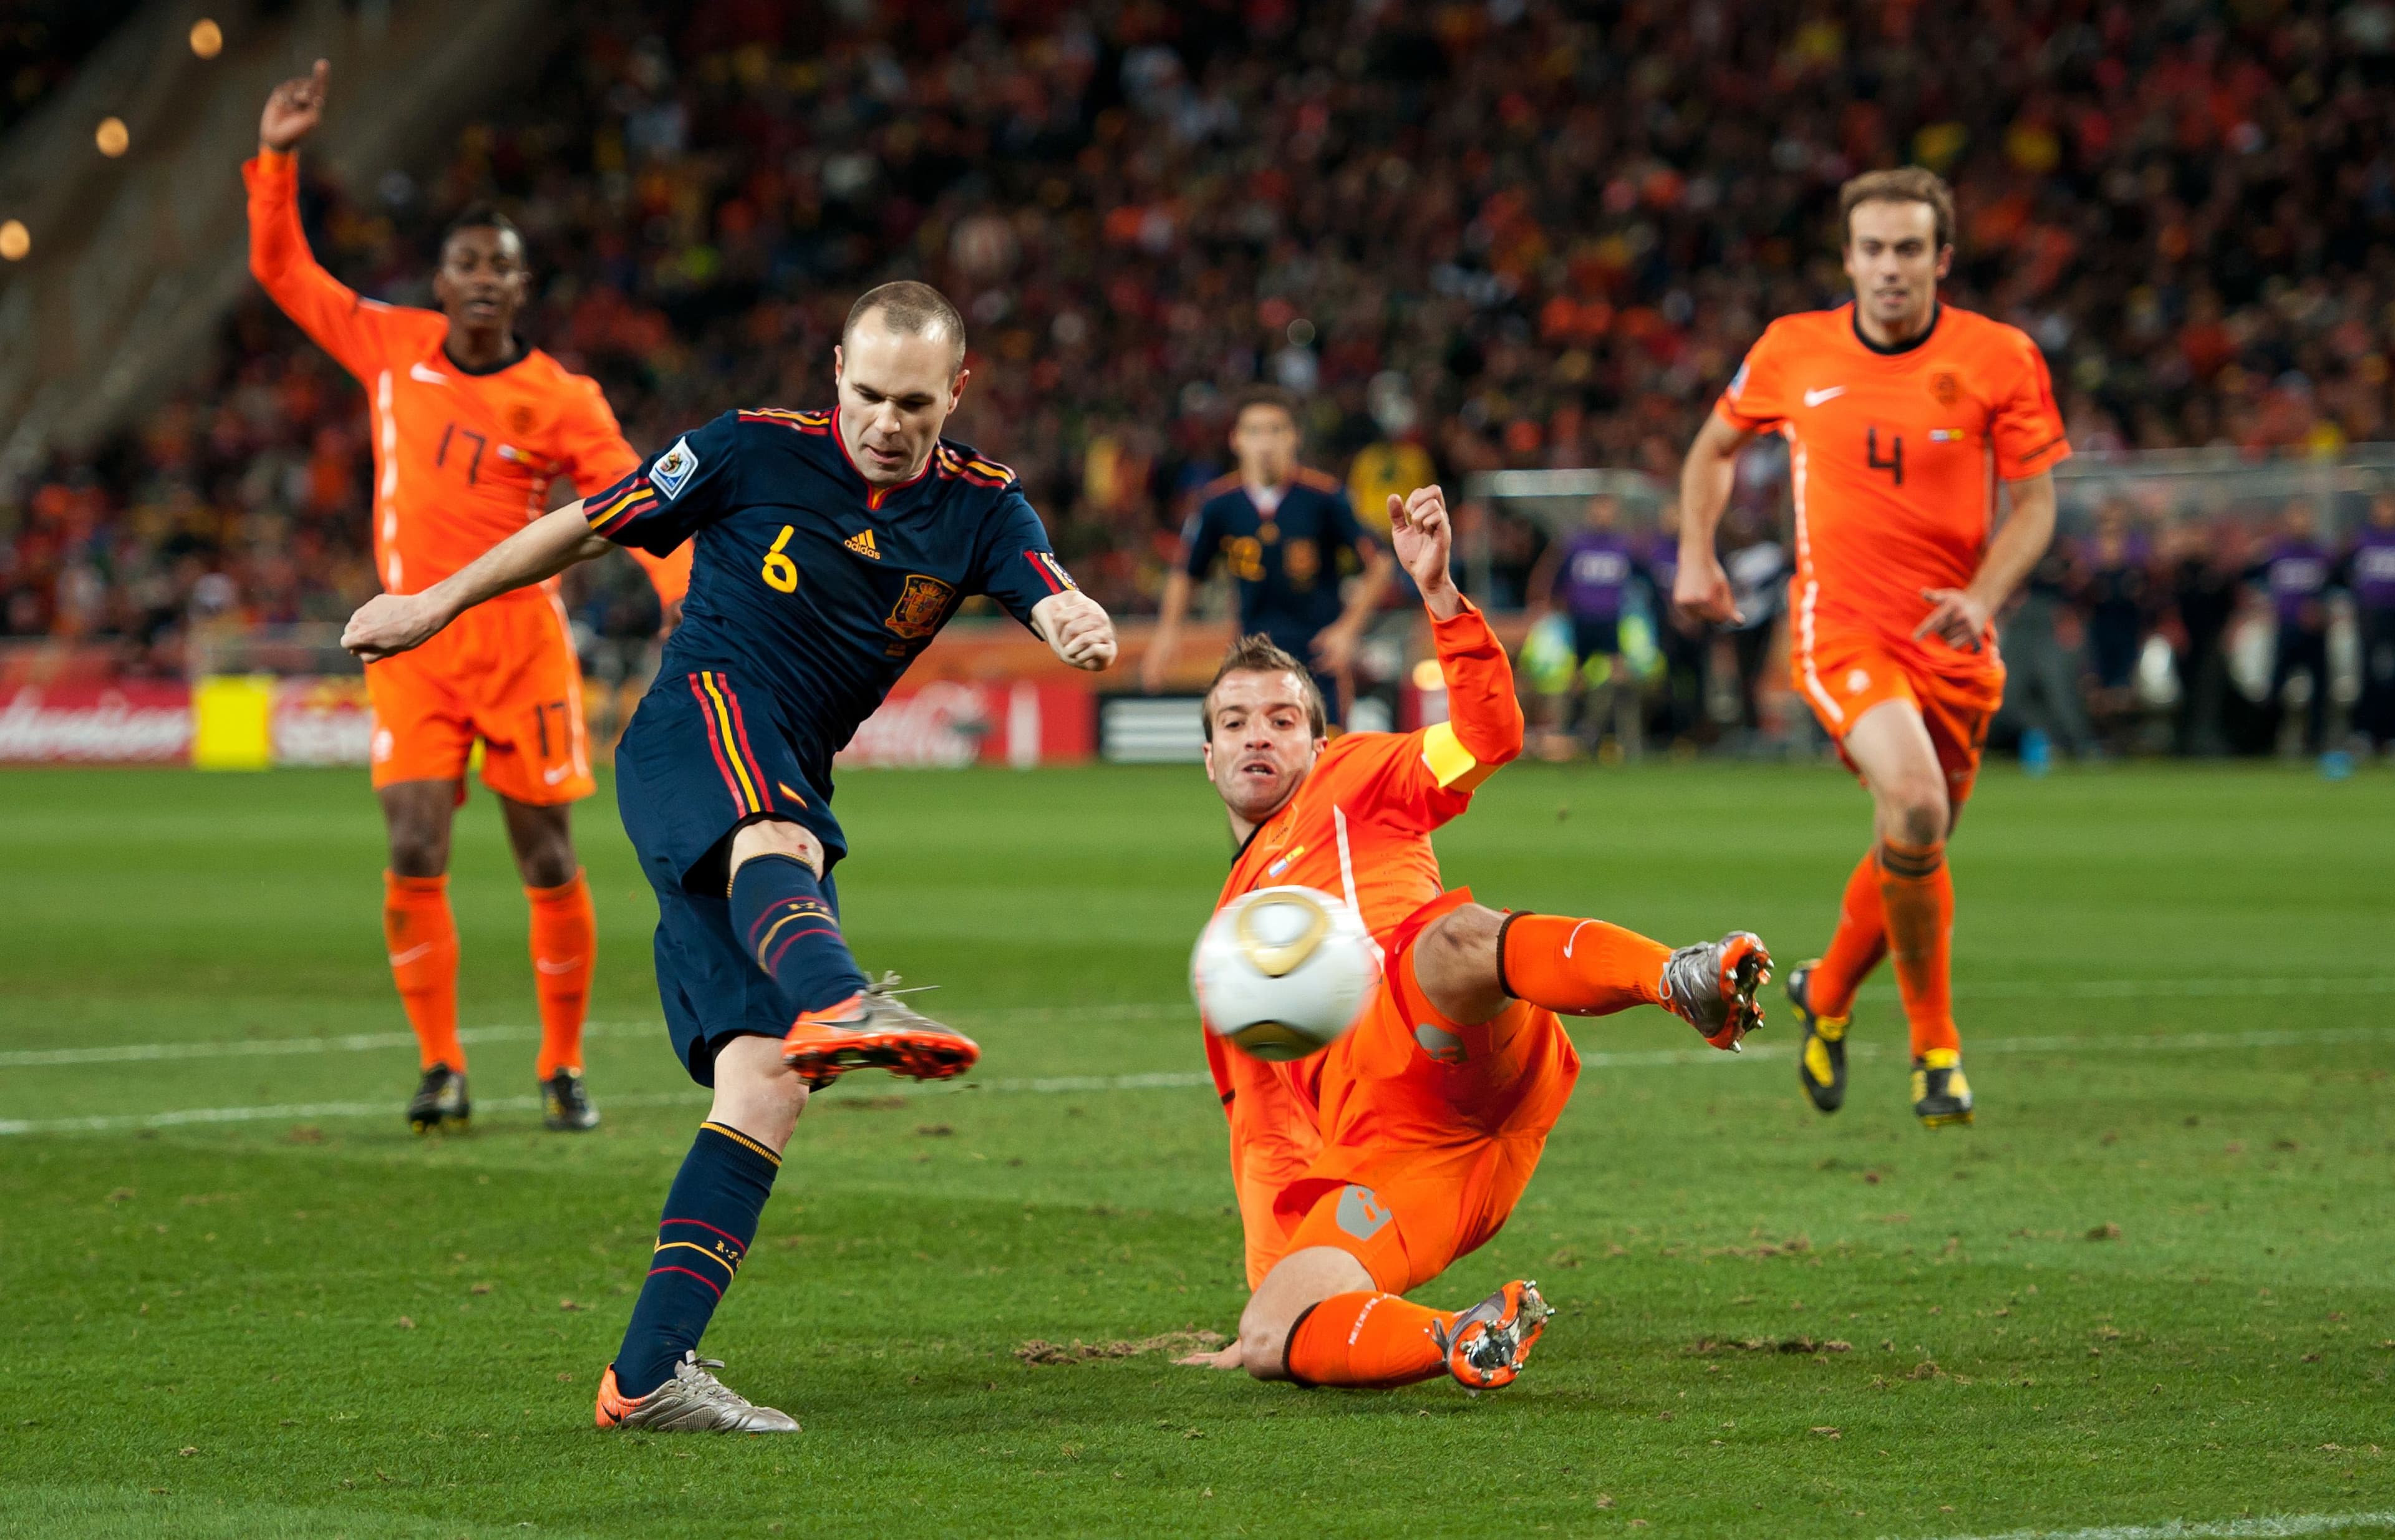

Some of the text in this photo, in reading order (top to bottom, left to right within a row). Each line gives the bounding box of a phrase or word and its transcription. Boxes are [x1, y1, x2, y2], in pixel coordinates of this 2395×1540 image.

[436, 423, 486, 485] 17
[1867, 425, 1903, 487] 4
[762, 525, 798, 593] 6
[844, 539, 881, 559] adidas
[536, 701, 573, 757] 17
